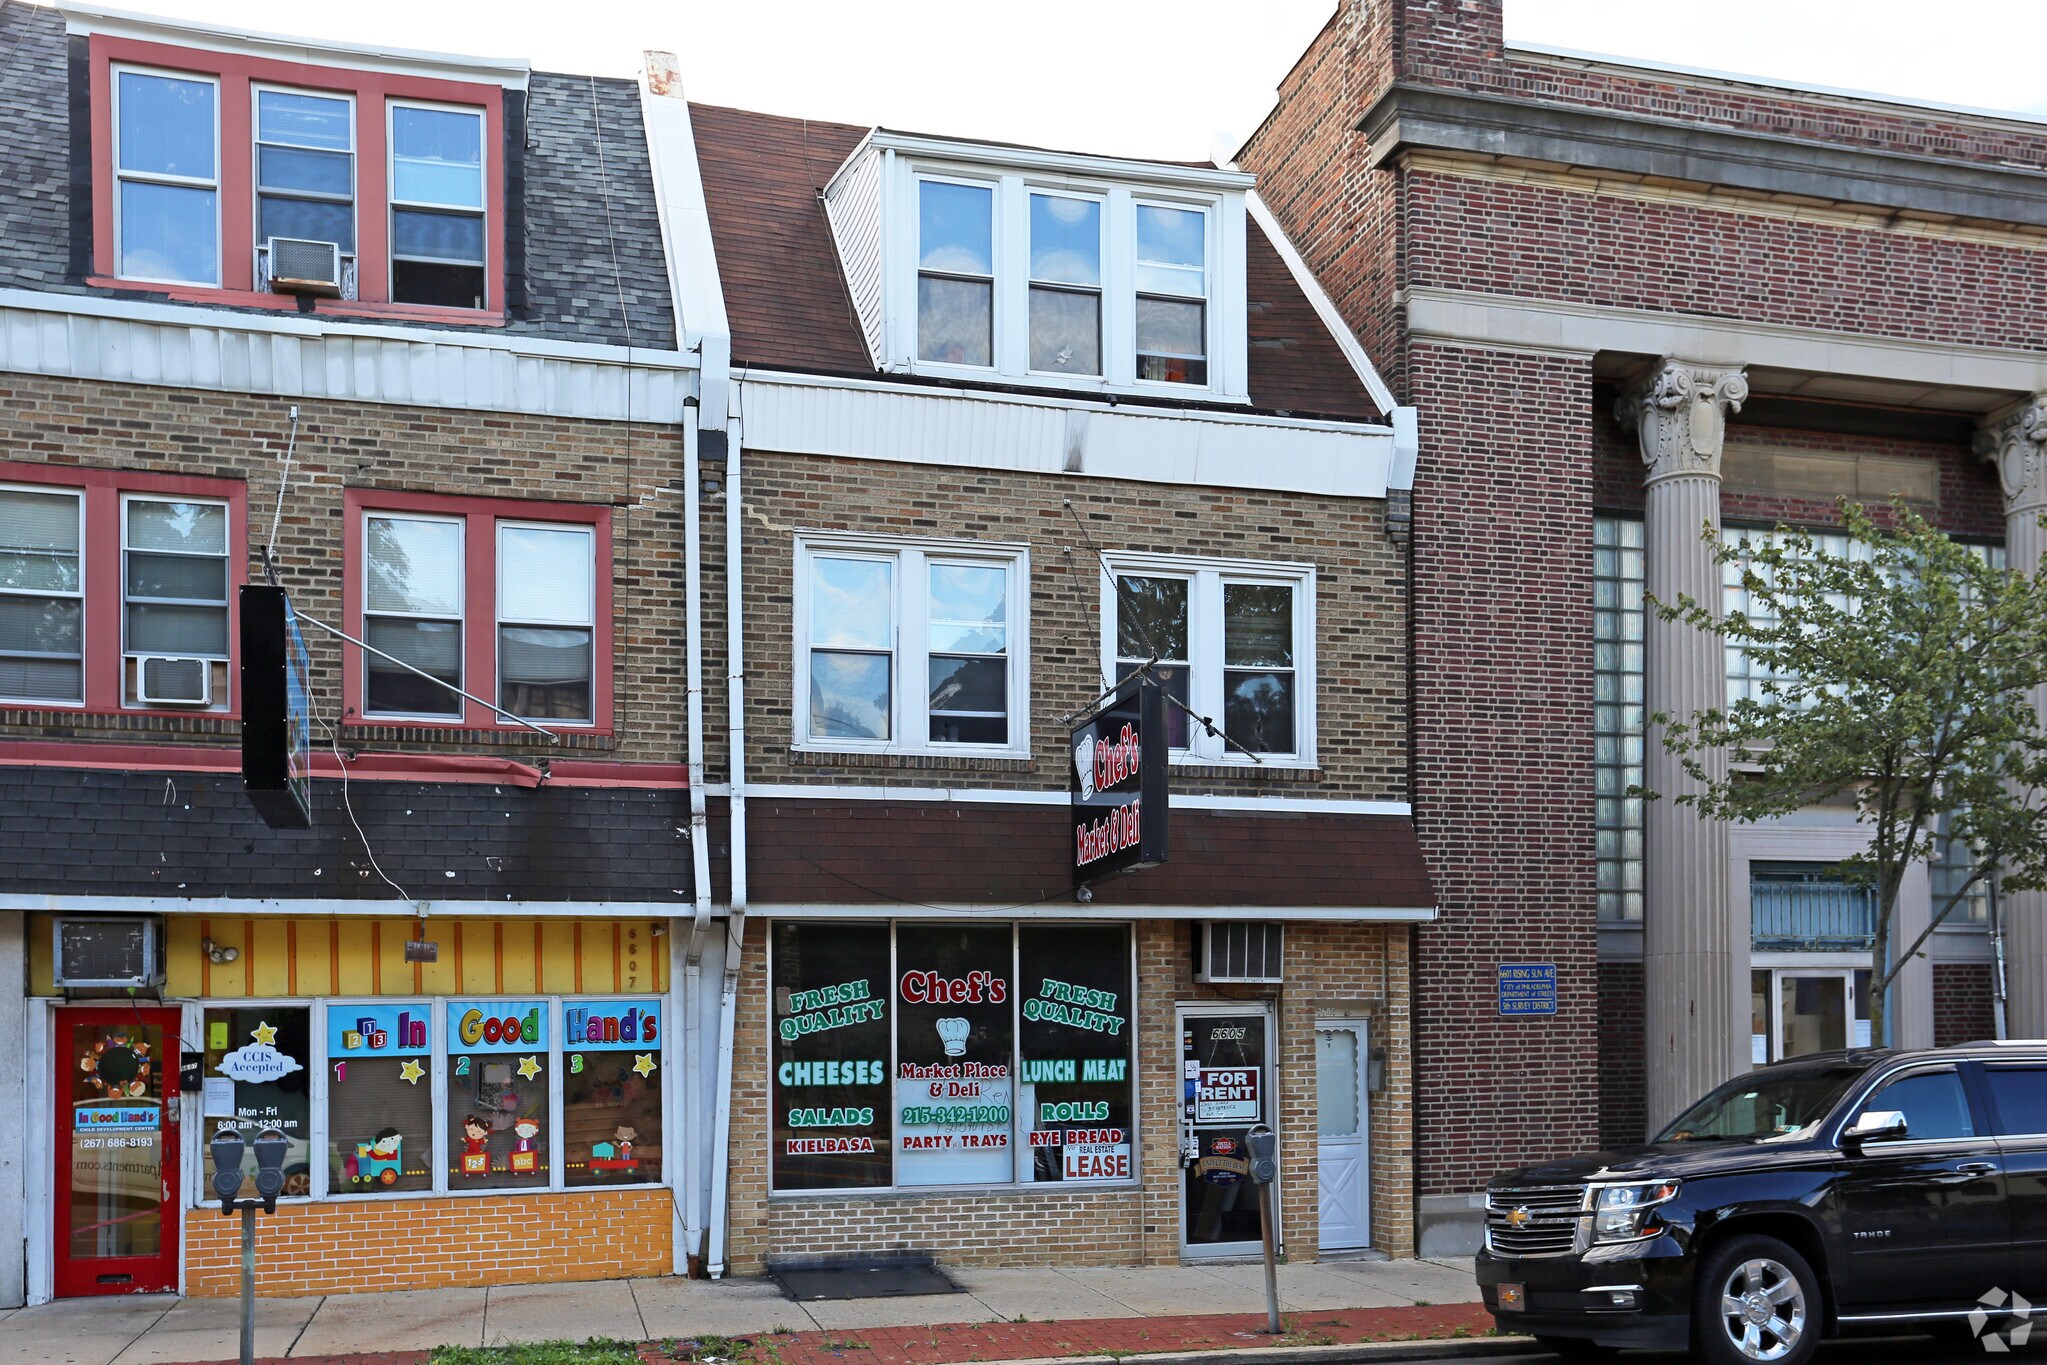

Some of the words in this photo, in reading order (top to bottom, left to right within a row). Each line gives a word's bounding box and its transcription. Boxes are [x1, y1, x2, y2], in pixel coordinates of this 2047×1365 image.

[1094, 722, 1139, 792] Chef's
[1077, 818, 1110, 866] Market
[1110, 808, 1119, 853] &
[1120, 799, 1140, 849] Deli
[628, 928, 637, 988] 6607
[1500, 969, 1511, 978] 6601
[1513, 969, 1530, 978] RISING
[1532, 969, 1542, 978] SUN
[900, 970, 1006, 1004] Chef's
[1040, 978, 1117, 1011] FRESH
[789, 979, 870, 1013] FRESH
[1512, 1002, 1531, 1010] SURVEY
[1532, 1001, 1554, 1010] DISTRICT
[780, 1000, 885, 1041] QUALITY
[1023, 998, 1125, 1035] QUALITY
[366, 1023, 373, 1033] 1
[398, 1011, 426, 1049] In
[459, 1007, 539, 1047] Good
[566, 1007, 657, 1045] Hand's
[1211, 1027, 1246, 1040] 6605
[352, 1036, 359, 1045] 2
[377, 1035, 384, 1045] 3
[243, 1052, 272, 1062] CCIS
[570, 1054, 584, 1074] 3
[231, 1062, 283, 1074] Accepted
[334, 1061, 346, 1082] 1
[455, 1056, 471, 1076] 2
[779, 1060, 884, 1086] CHEESES
[901, 1062, 960, 1079] Market
[964, 1062, 1007, 1078] Place
[1022, 1060, 1076, 1083] LUNCH
[1082, 1060, 1126, 1082] MEAT
[1208, 1072, 1248, 1085] FOR
[929, 1082, 943, 1098] &
[947, 1081, 980, 1097] Deli
[1201, 1087, 1254, 1100] RENT
[79, 1112, 89, 1124] In
[91, 1111, 119, 1124] Good
[121, 1110, 154, 1123] Hand's
[238, 1108, 257, 1117] Mon
[266, 1107, 278, 1116] Fri
[789, 1107, 873, 1127] SALADS
[903, 1106, 1009, 1125] 215-342-1200
[1041, 1101, 1109, 1122] ROLLS
[217, 1121, 237, 1130] 6:00
[80, 1138, 105, 1149] (267)
[107, 1137, 153, 1147] 686-8193
[903, 1135, 953, 1150] PARTY
[961, 1134, 1008, 1149] TRAYS
[1029, 1130, 1061, 1147] RYE
[1066, 1128, 1123, 1146] BREAD
[788, 1138, 874, 1155] KIELBASA
[1095, 1145, 1115, 1153] ESTATE
[467, 1157, 485, 1169] 123
[514, 1157, 533, 1166] abc
[1066, 1155, 1128, 1177] LEASE
[1853, 1230, 1891, 1239] TAHOE
